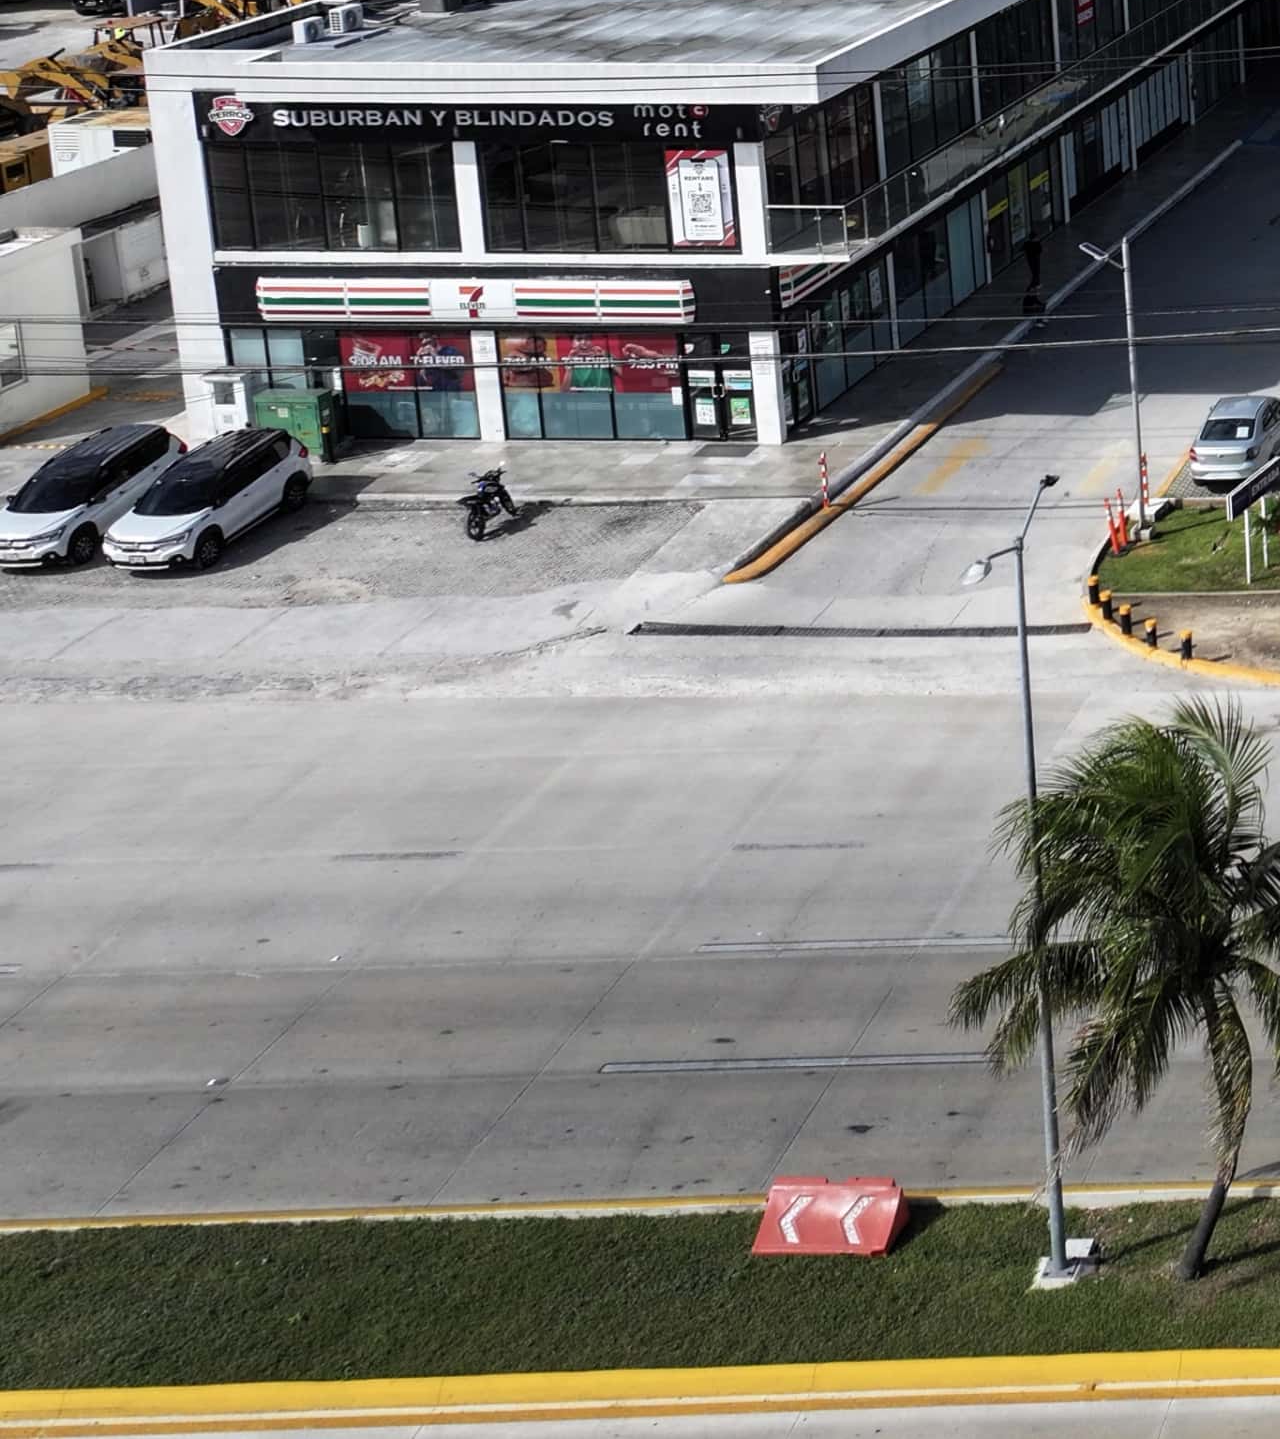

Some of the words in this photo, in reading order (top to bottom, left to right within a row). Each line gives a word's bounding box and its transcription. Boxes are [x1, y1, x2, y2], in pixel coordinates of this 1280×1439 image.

[273, 110, 423, 127] SUBURBAN
[430, 111, 447, 126] Y
[455, 110, 615, 128] BLINDADOS
[643, 122, 703, 139] rent
[379, 355, 403, 366] AM
